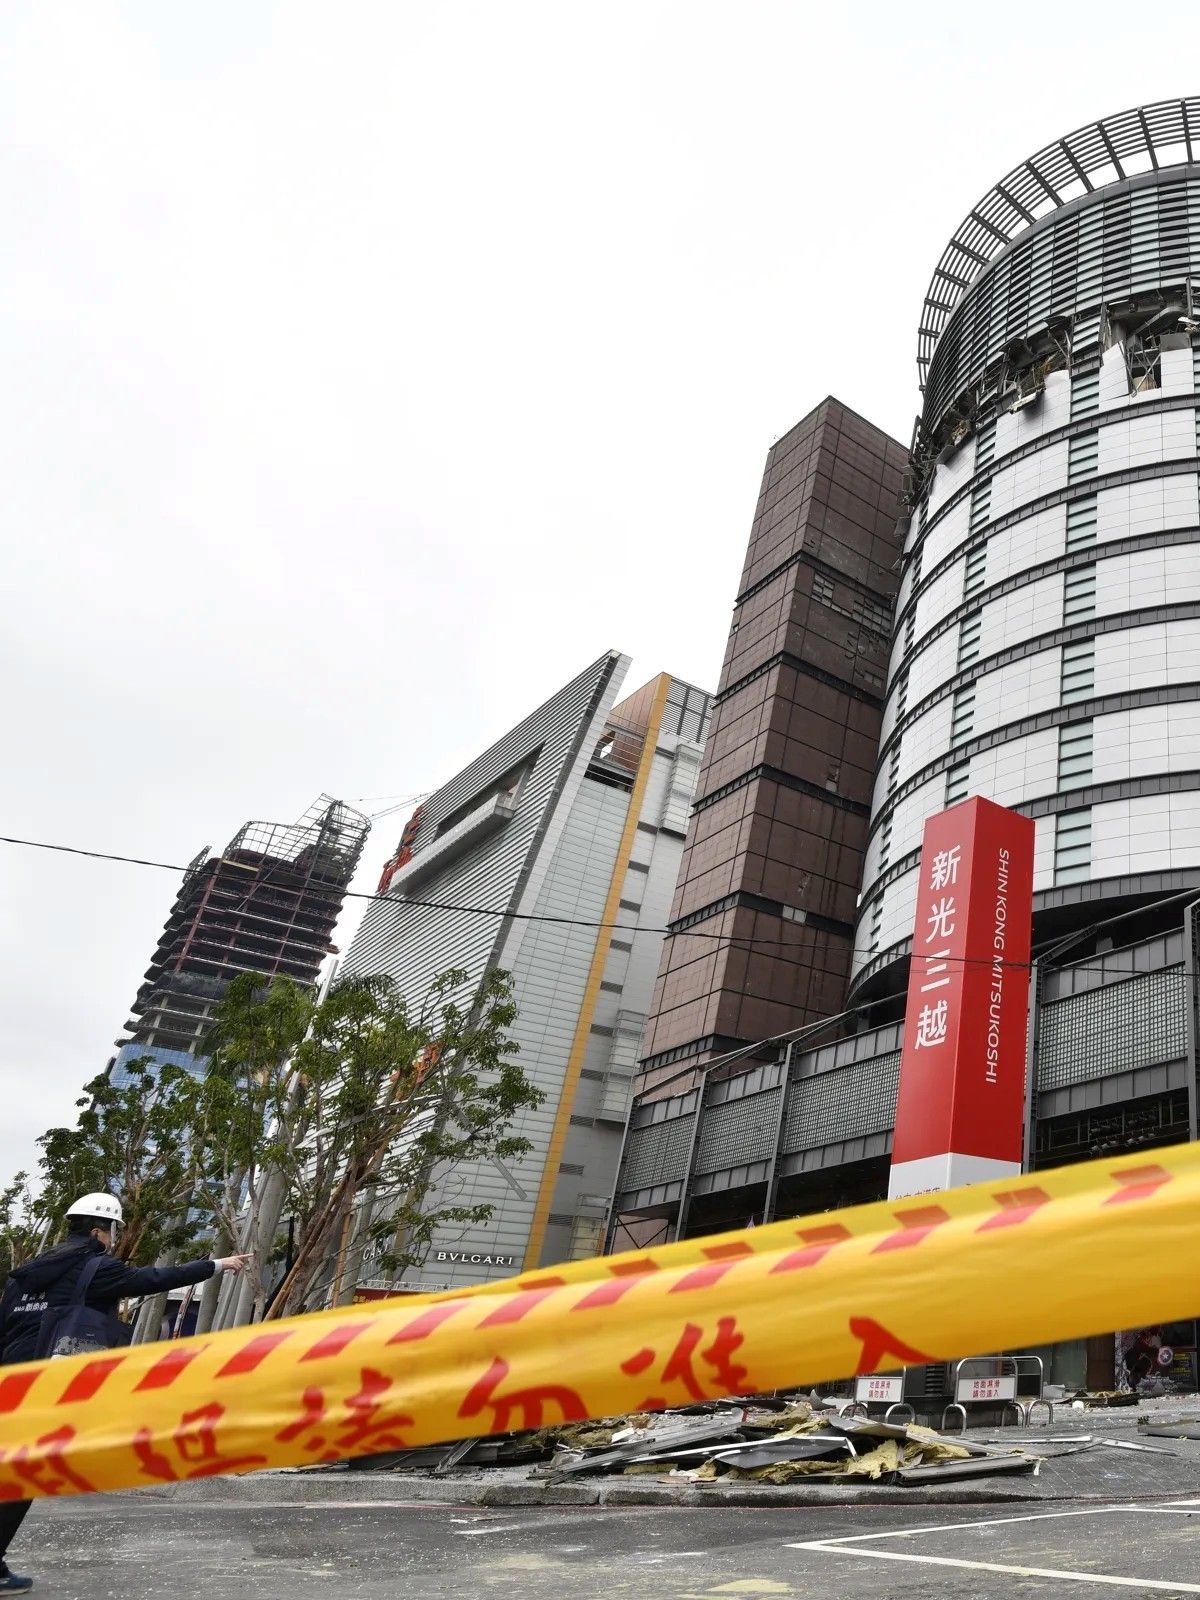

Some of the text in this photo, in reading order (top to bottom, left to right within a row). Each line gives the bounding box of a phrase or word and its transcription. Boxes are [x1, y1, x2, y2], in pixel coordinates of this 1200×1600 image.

[914, 844, 961, 1051] 新光三越
[985, 847, 1010, 1083] SHIN KONG MITSUKOSHI
[437, 1252, 513, 1265] BVLGARI
